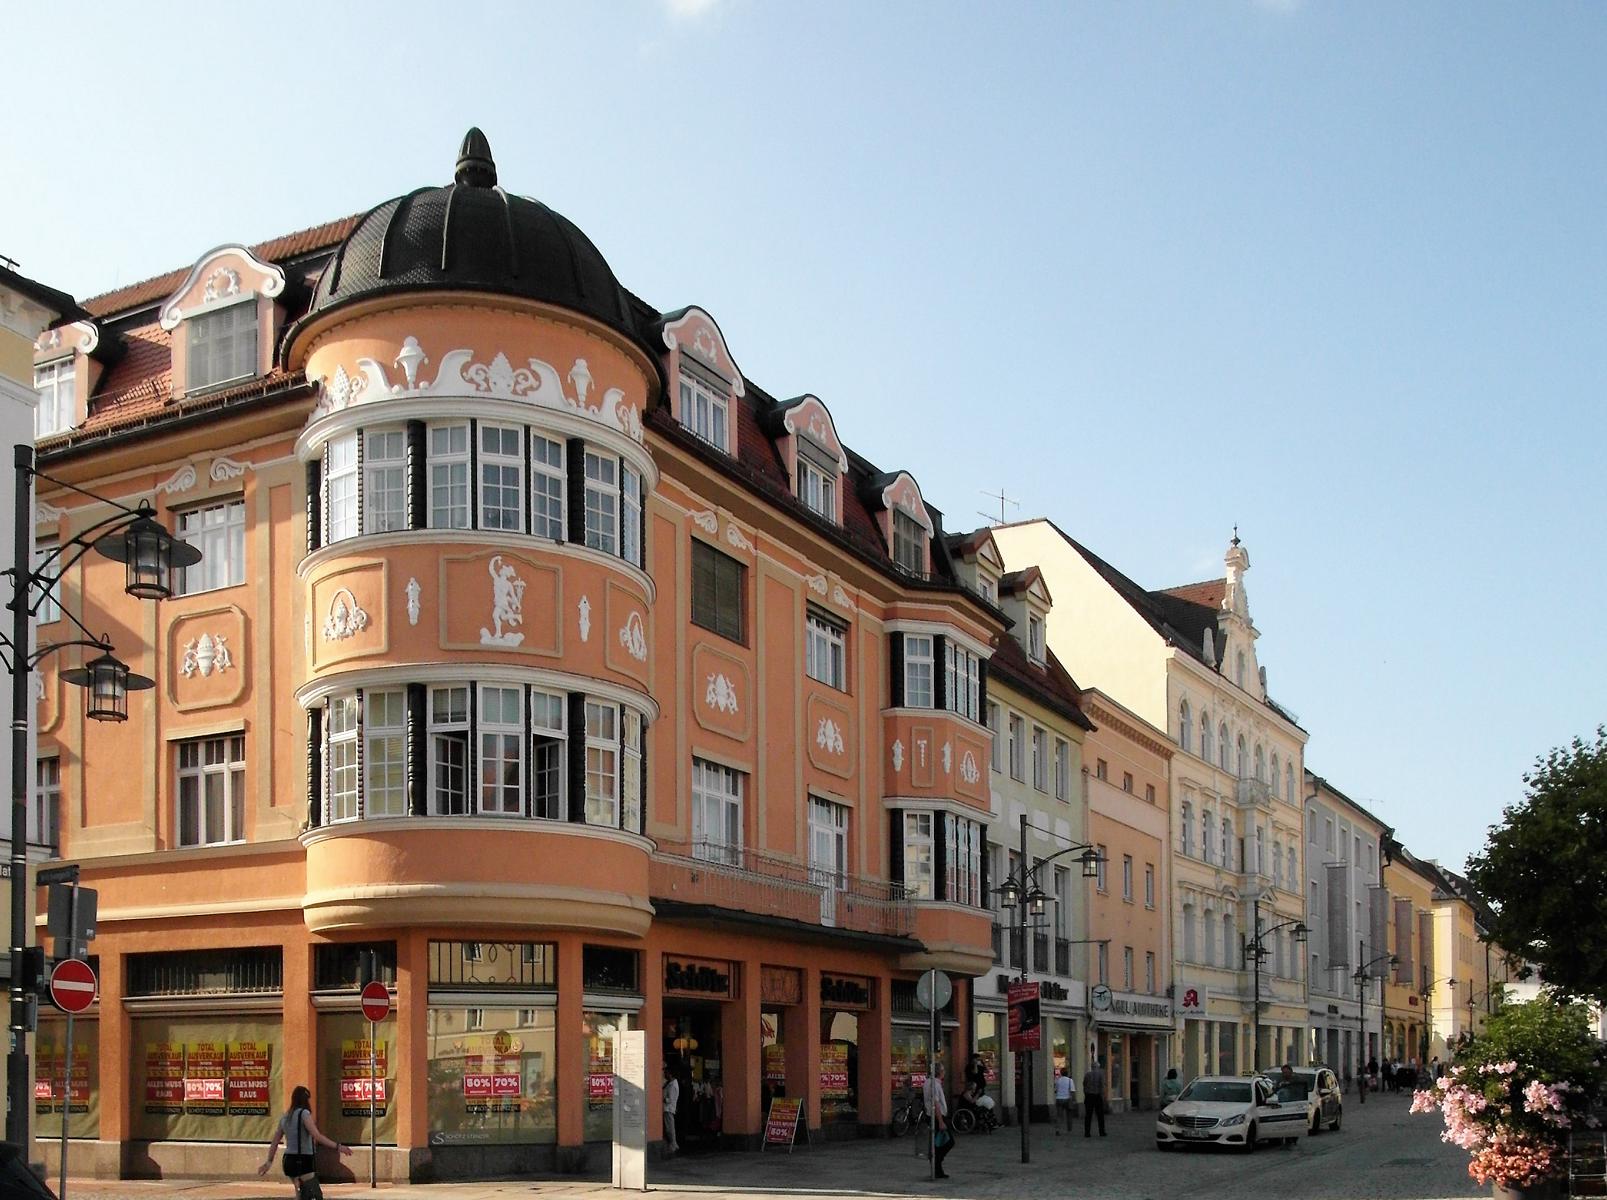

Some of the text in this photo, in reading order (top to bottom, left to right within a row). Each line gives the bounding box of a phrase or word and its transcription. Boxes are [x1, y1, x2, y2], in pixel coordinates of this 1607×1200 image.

[229, 1080, 268, 1089] ALLES MUSS
[495, 1077, 518, 1087] 70%
[239, 1091, 257, 1099] RAUS
